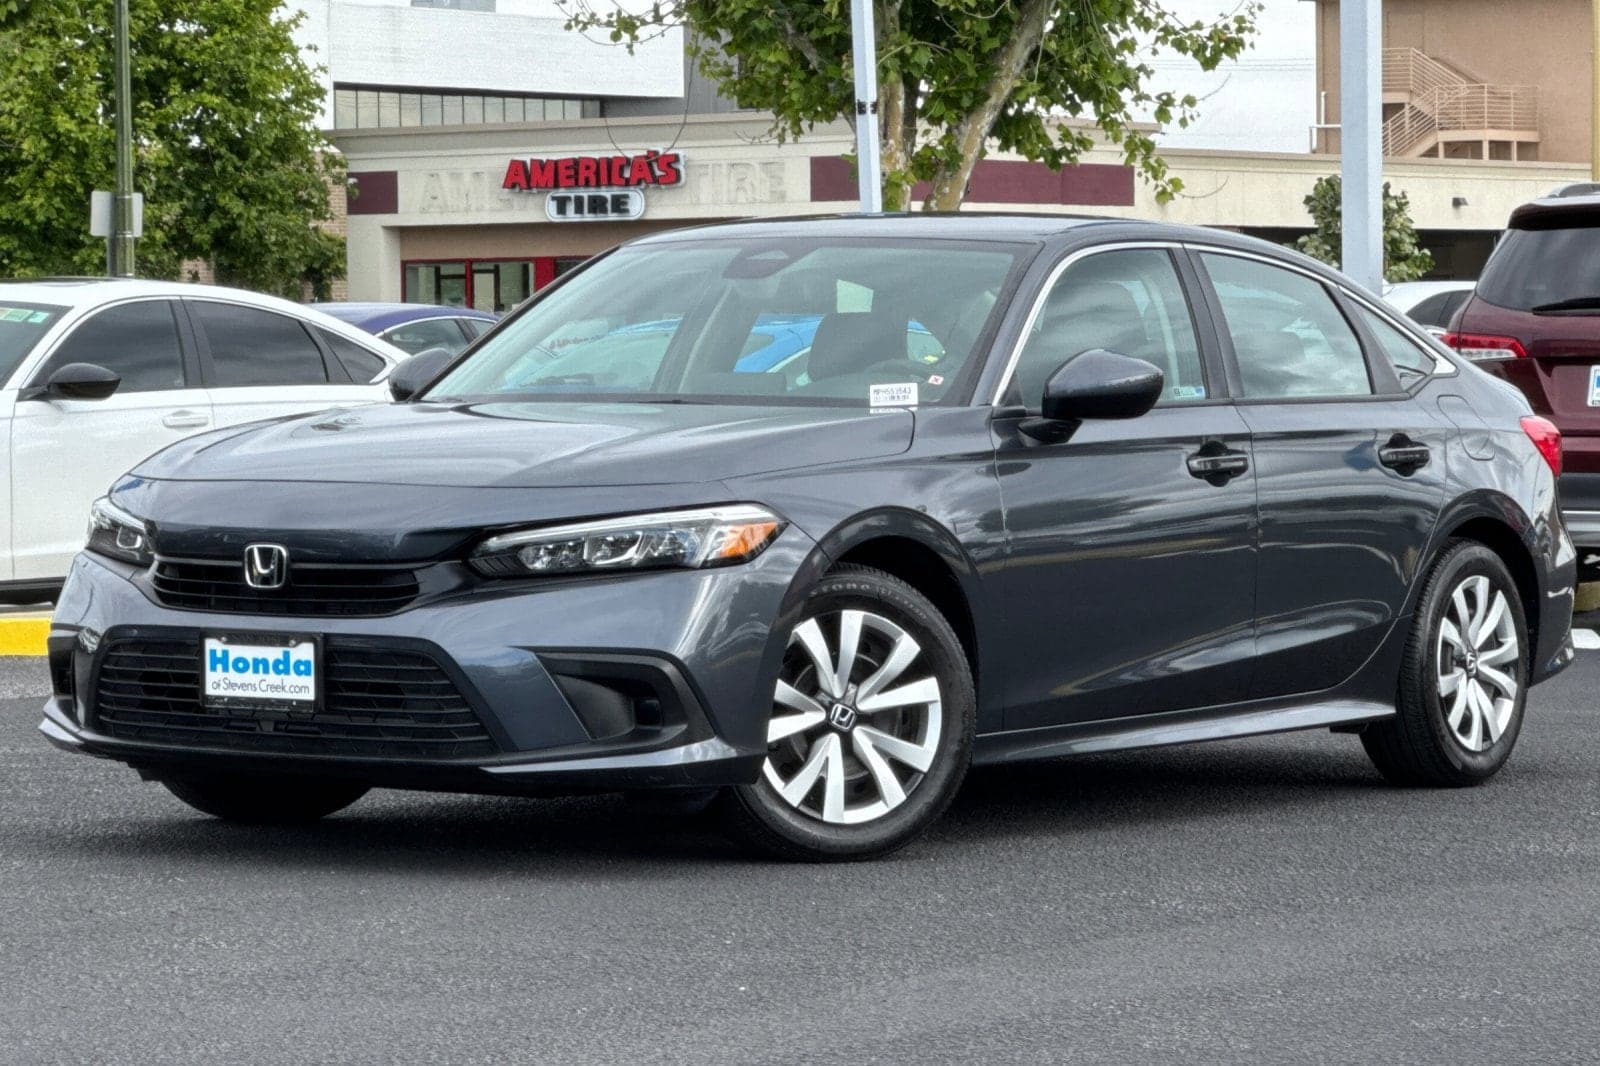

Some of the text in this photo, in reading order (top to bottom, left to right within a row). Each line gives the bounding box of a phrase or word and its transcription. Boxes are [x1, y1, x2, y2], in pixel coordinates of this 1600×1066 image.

[503, 151, 682, 189] AMERICA'S
[551, 193, 630, 216] TIRE
[209, 649, 312, 676] Honda
[211, 677, 310, 694] of Stevens Creek.com
